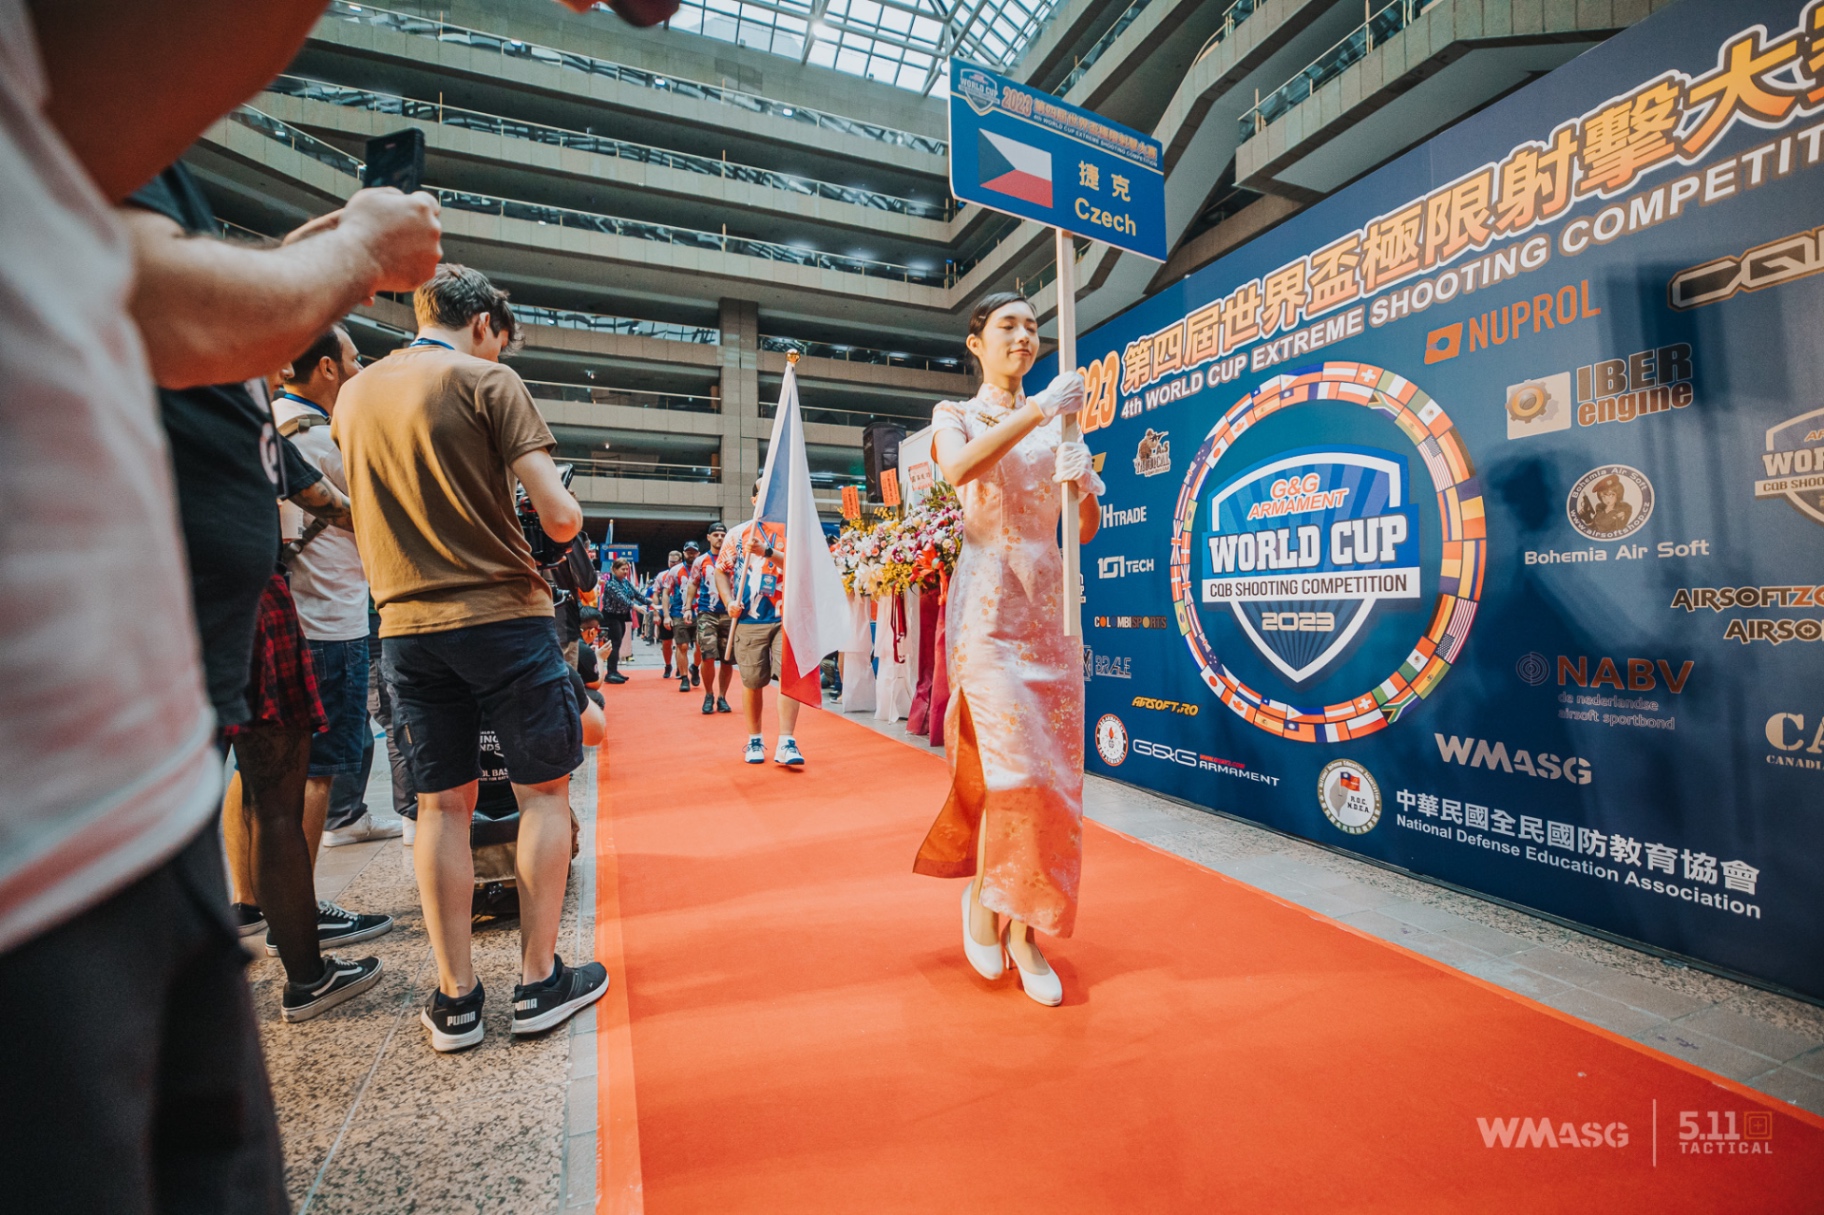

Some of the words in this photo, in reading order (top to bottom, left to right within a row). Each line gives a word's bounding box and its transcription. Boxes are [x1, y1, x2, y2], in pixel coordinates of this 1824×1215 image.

[985, 87, 999, 98] CUP
[1002, 86, 1033, 117] 2023
[1043, 118, 1063, 130] WORLD
[1064, 125, 1075, 134] CUP
[1076, 131, 1100, 144] EXTREME
[1121, 0, 1824, 396] 第四屆世界盃極限射擊大
[1075, 198, 1136, 237] Czech
[1121, 396, 1142, 419] 4th
[1145, 371, 1203, 410] WORLD
[1207, 355, 1247, 389] CUP
[1250, 309, 1364, 373] EXTREME
[1370, 236, 1549, 326] SHOOTING
[1469, 279, 1601, 352] NUPROL
[1577, 343, 1693, 402] IBER
[1577, 380, 1694, 427] engine
[1270, 472, 1320, 500] G&G
[1571, 469, 1607, 499] Bohemia
[1629, 472, 1648, 491] Soft
[1247, 487, 1349, 520] ARMAMENT
[1570, 501, 1650, 538] www.airsoftshop.cz
[1208, 523, 1321, 574] WORLD
[1330, 514, 1408, 566] CUP
[1524, 547, 1607, 564] Bohemia
[1615, 544, 1648, 560] Air
[1657, 539, 1710, 558] Soft
[1126, 559, 1154, 573] TECH
[1210, 583, 1232, 597] CQB
[1235, 579, 1298, 597] SHOOTING
[1302, 574, 1407, 595] COMPETITION
[1261, 611, 1336, 632] 2023
[1557, 655, 1695, 694] NABV
[1131, 695, 1200, 717] AIRSOFT.RO
[1557, 691, 1574, 704] de
[1576, 694, 1660, 712] nederlandse
[1557, 708, 1600, 723] airsoft
[1602, 713, 1676, 731] sportbond
[1132, 739, 1198, 768] G&G
[1434, 732, 1592, 785] WMASG
[1199, 760, 1280, 788] ARMAMENT
[1396, 789, 1761, 896] 中華民國全民國防教育協會
[1396, 813, 1452, 840] National
[1456, 829, 1521, 857] Defense
[1525, 846, 1620, 883] Education
[1624, 870, 1762, 920] Association
[446, 1011, 476, 1027] PUMA
